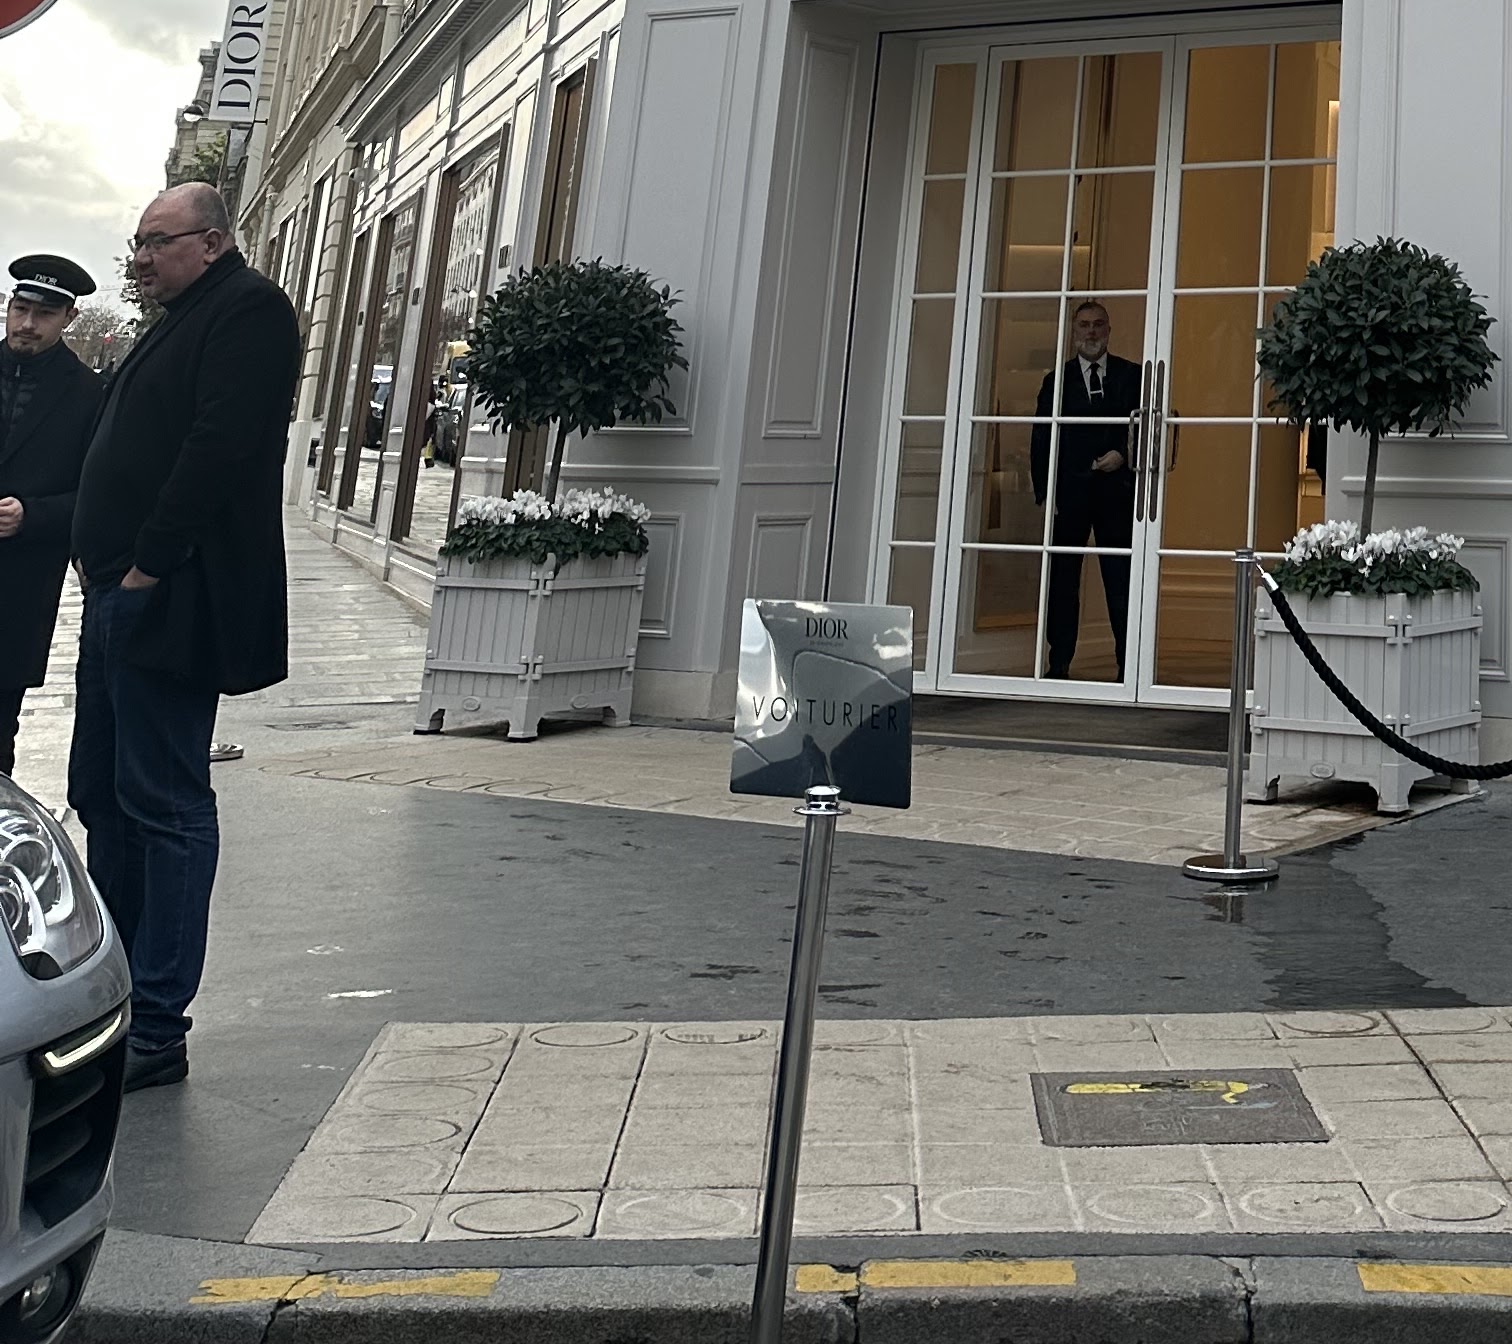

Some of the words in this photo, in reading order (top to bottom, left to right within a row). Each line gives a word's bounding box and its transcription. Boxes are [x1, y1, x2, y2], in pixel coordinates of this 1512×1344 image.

[217, 2, 268, 110] DIOR
[33, 273, 58, 286] DIOR
[805, 617, 848, 640] DIOR
[752, 695, 898, 731] VOITURIER
